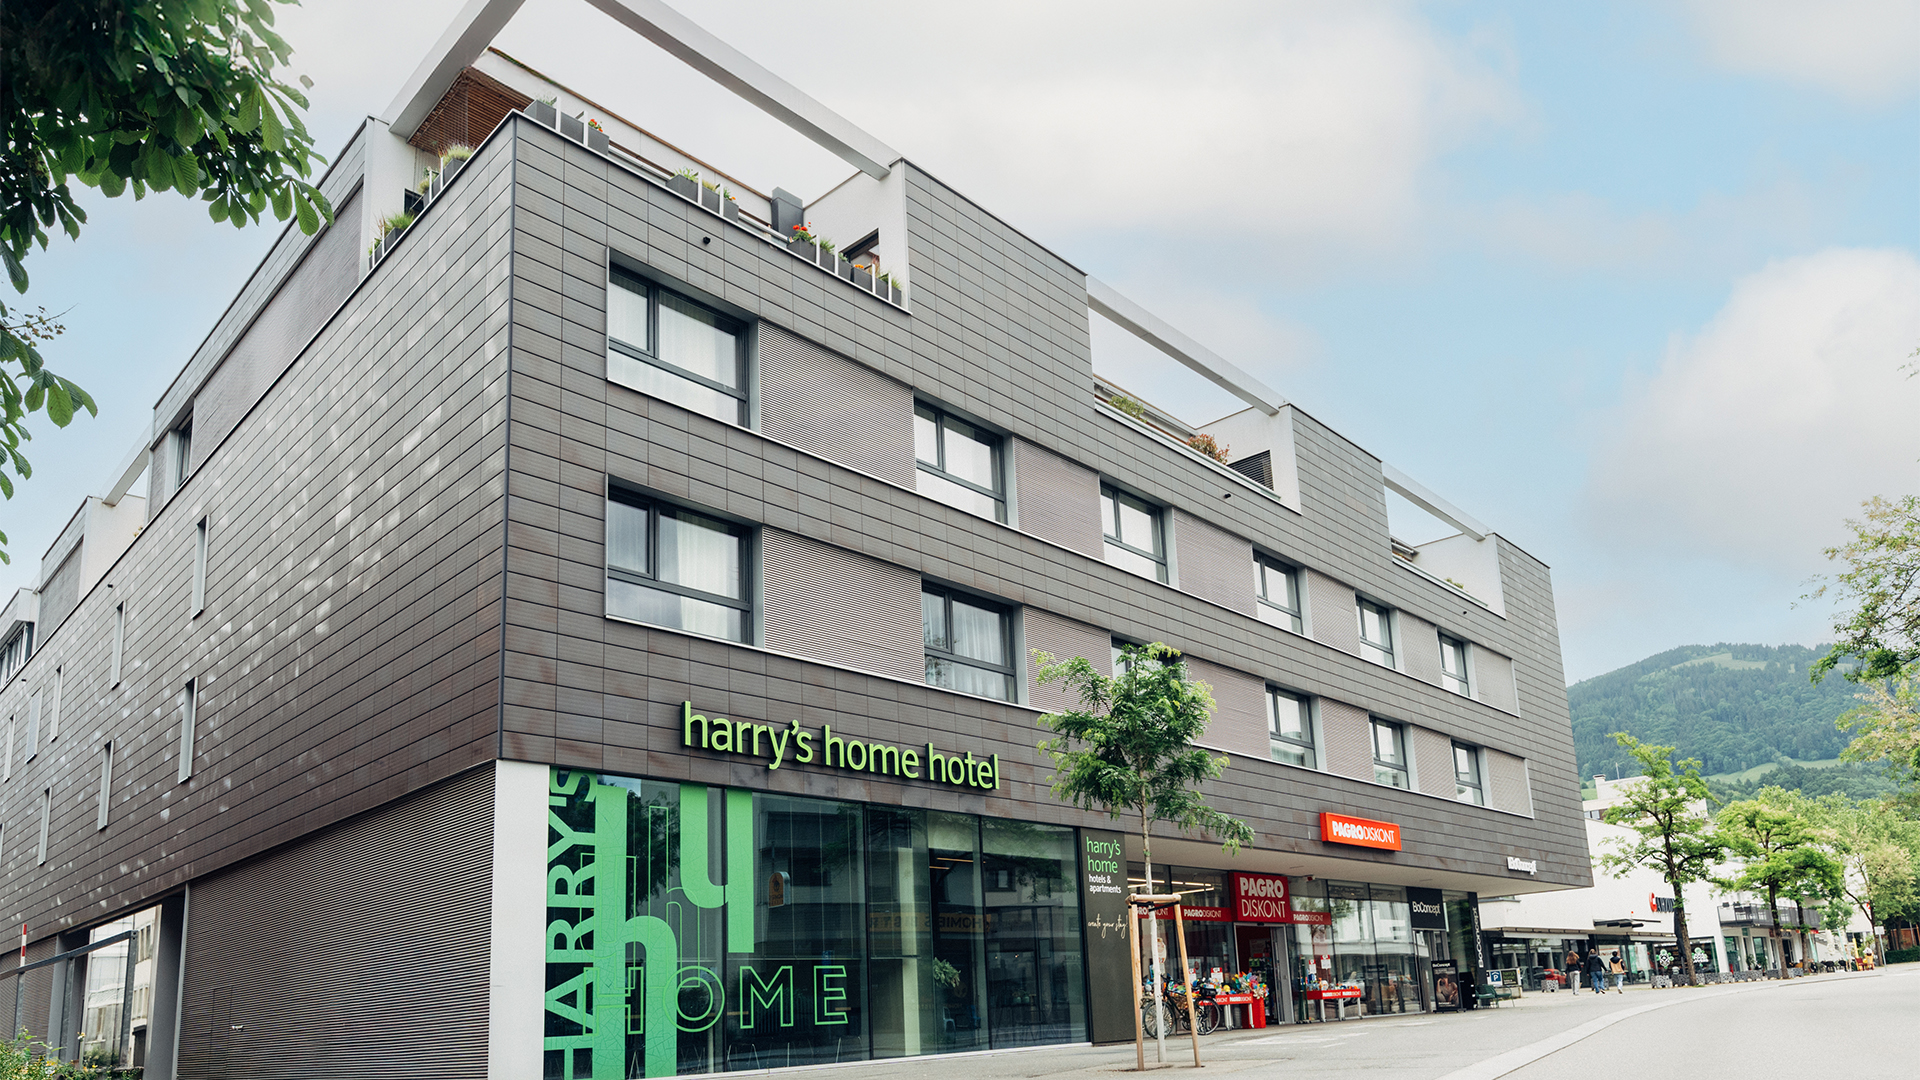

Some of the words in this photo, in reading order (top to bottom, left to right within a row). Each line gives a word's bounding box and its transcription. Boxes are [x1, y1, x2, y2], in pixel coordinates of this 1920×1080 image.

[682, 700, 814, 770] harry's
[823, 724, 920, 779] home
[926, 742, 1000, 790] hotel
[1331, 820, 1395, 844] PAGRODISKONT
[1086, 836, 1121, 858] harry's
[1087, 855, 1119, 873] home
[1088, 873, 1107, 884] hotels
[1107, 875, 1112, 884] &
[1239, 877, 1284, 898] PAGRO
[1089, 885, 1122, 894] apartments
[1184, 908, 1221, 918] PAGRODISKONT
[1241, 899, 1286, 918] DISKONT
[1412, 900, 1441, 916] BoConcept
[1101, 922, 1115, 939] your
[1472, 907, 1484, 968] BoConcept
[582, 965, 849, 1036] HOME
